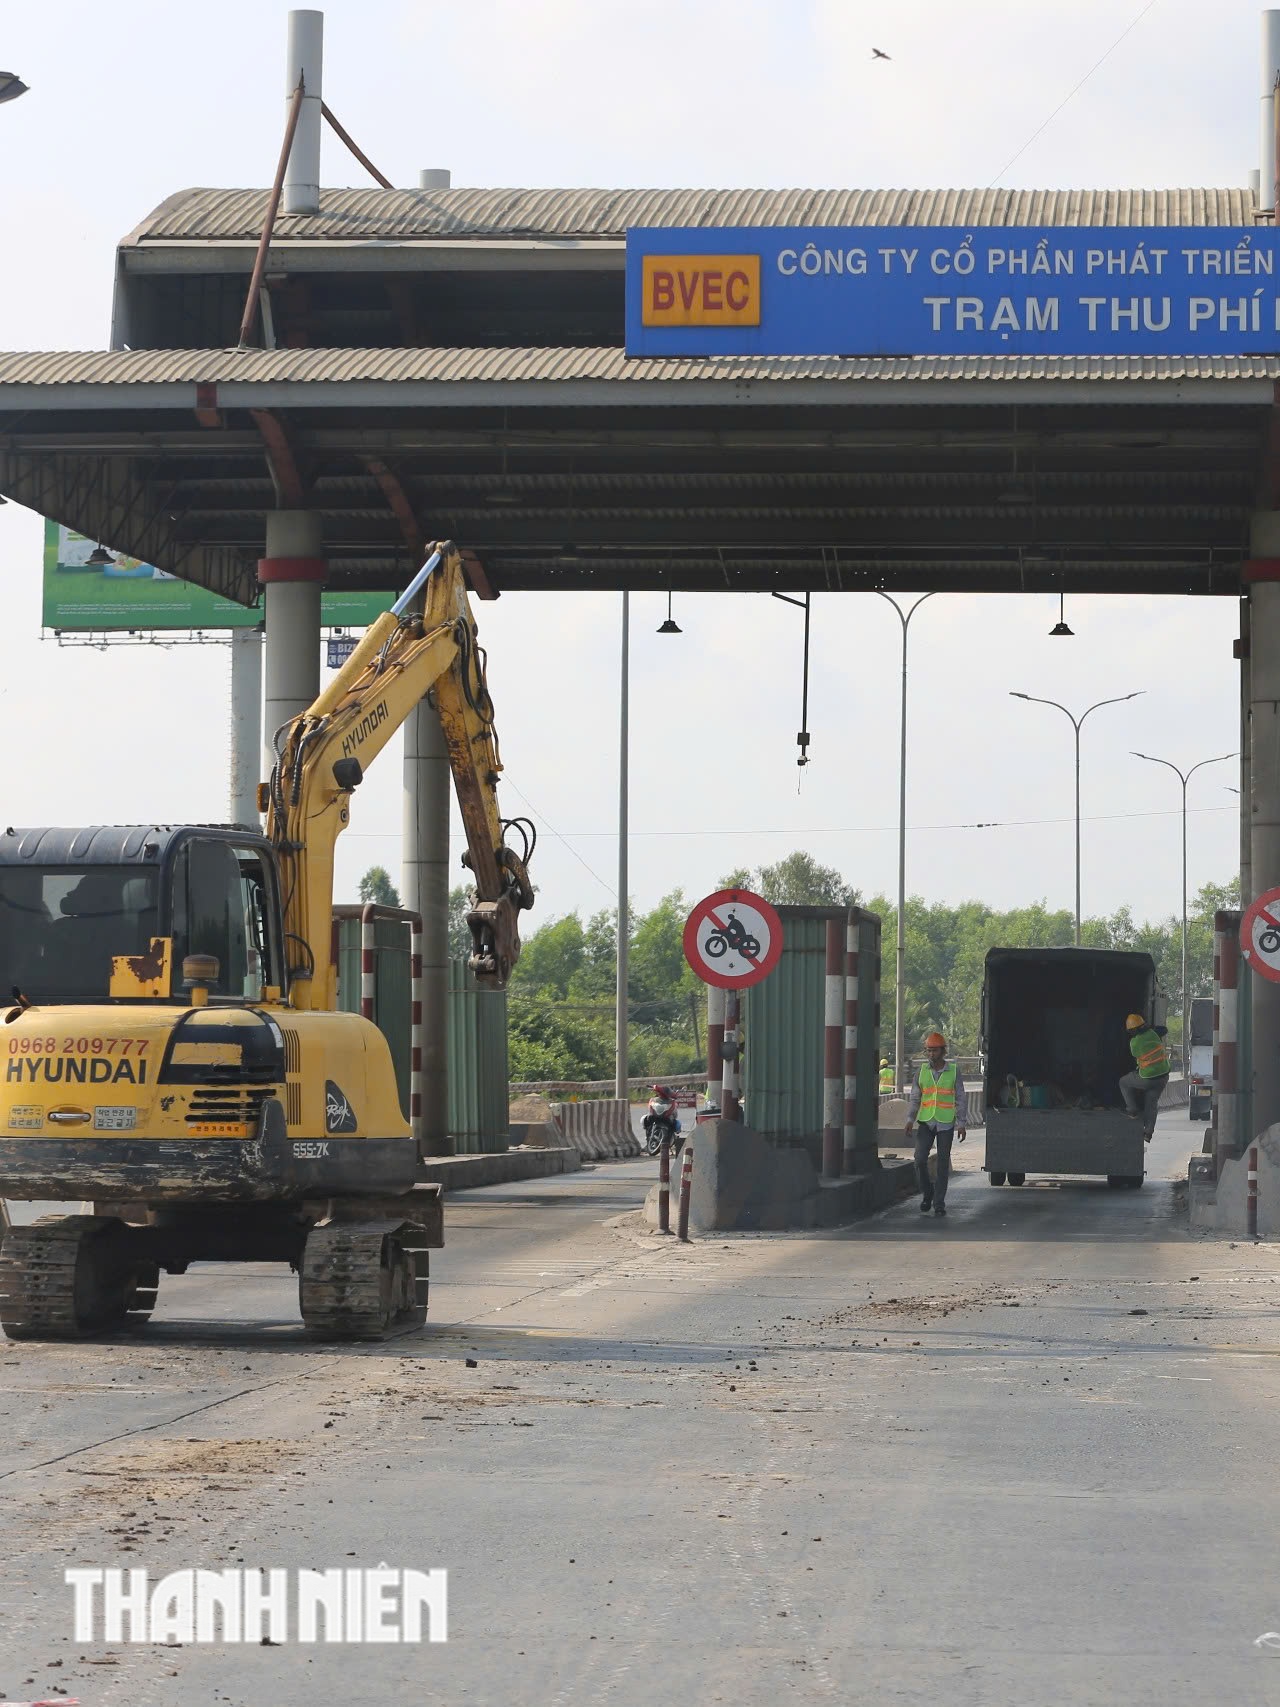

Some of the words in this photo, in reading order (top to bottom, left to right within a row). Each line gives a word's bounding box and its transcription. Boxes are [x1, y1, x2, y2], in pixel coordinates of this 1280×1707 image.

[777, 242, 867, 276] CÔNG
[878, 248, 919, 274] TY
[930, 234, 976, 275] CỔ
[988, 238, 1074, 275] PHẦN
[1086, 242, 1169, 275] PHÁT
[1181, 235, 1273, 275] TRIỂN
[652, 271, 750, 312] BVEC
[923, 297, 1059, 341] TRẠM
[1079, 297, 1171, 332] THU
[1189, 288, 1266, 332] PHÍ
[342, 699, 389, 759] HYUNDAI
[8, 1037, 57, 1055] 0968
[62, 1037, 150, 1056] 209777
[6, 1057, 147, 1085] HYUNDAI
